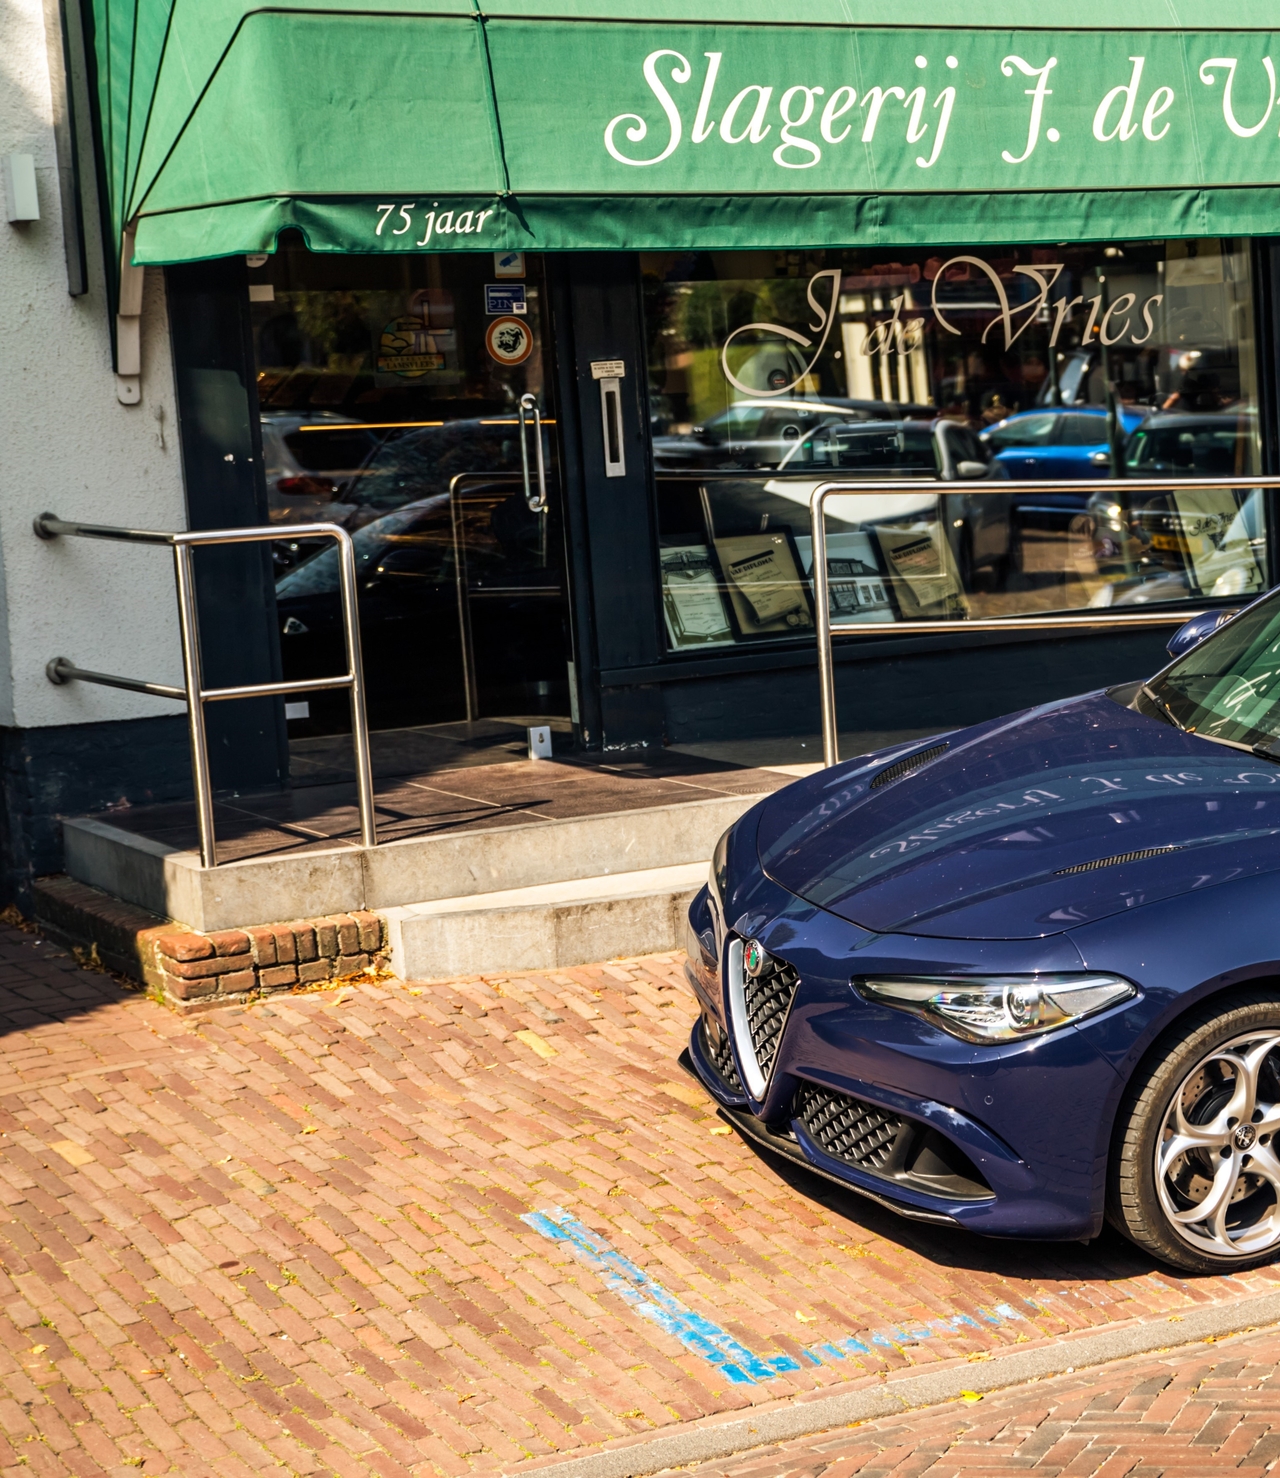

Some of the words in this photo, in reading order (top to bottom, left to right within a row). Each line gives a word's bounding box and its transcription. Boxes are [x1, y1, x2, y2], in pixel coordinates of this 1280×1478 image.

[603, 49, 959, 169] Slagerij
[1000, 54, 1061, 164] J.
[1092, 56, 1175, 142] de
[375, 203, 416, 236] 75
[416, 201, 494, 247] jaar
[488, 299, 514, 309] PIN
[860, 294, 925, 356] de
[931, 255, 1164, 352] Vries
[743, 556, 773, 571] DIPLOMA
[1201, 1012, 1268, 1045] MICHELIN
